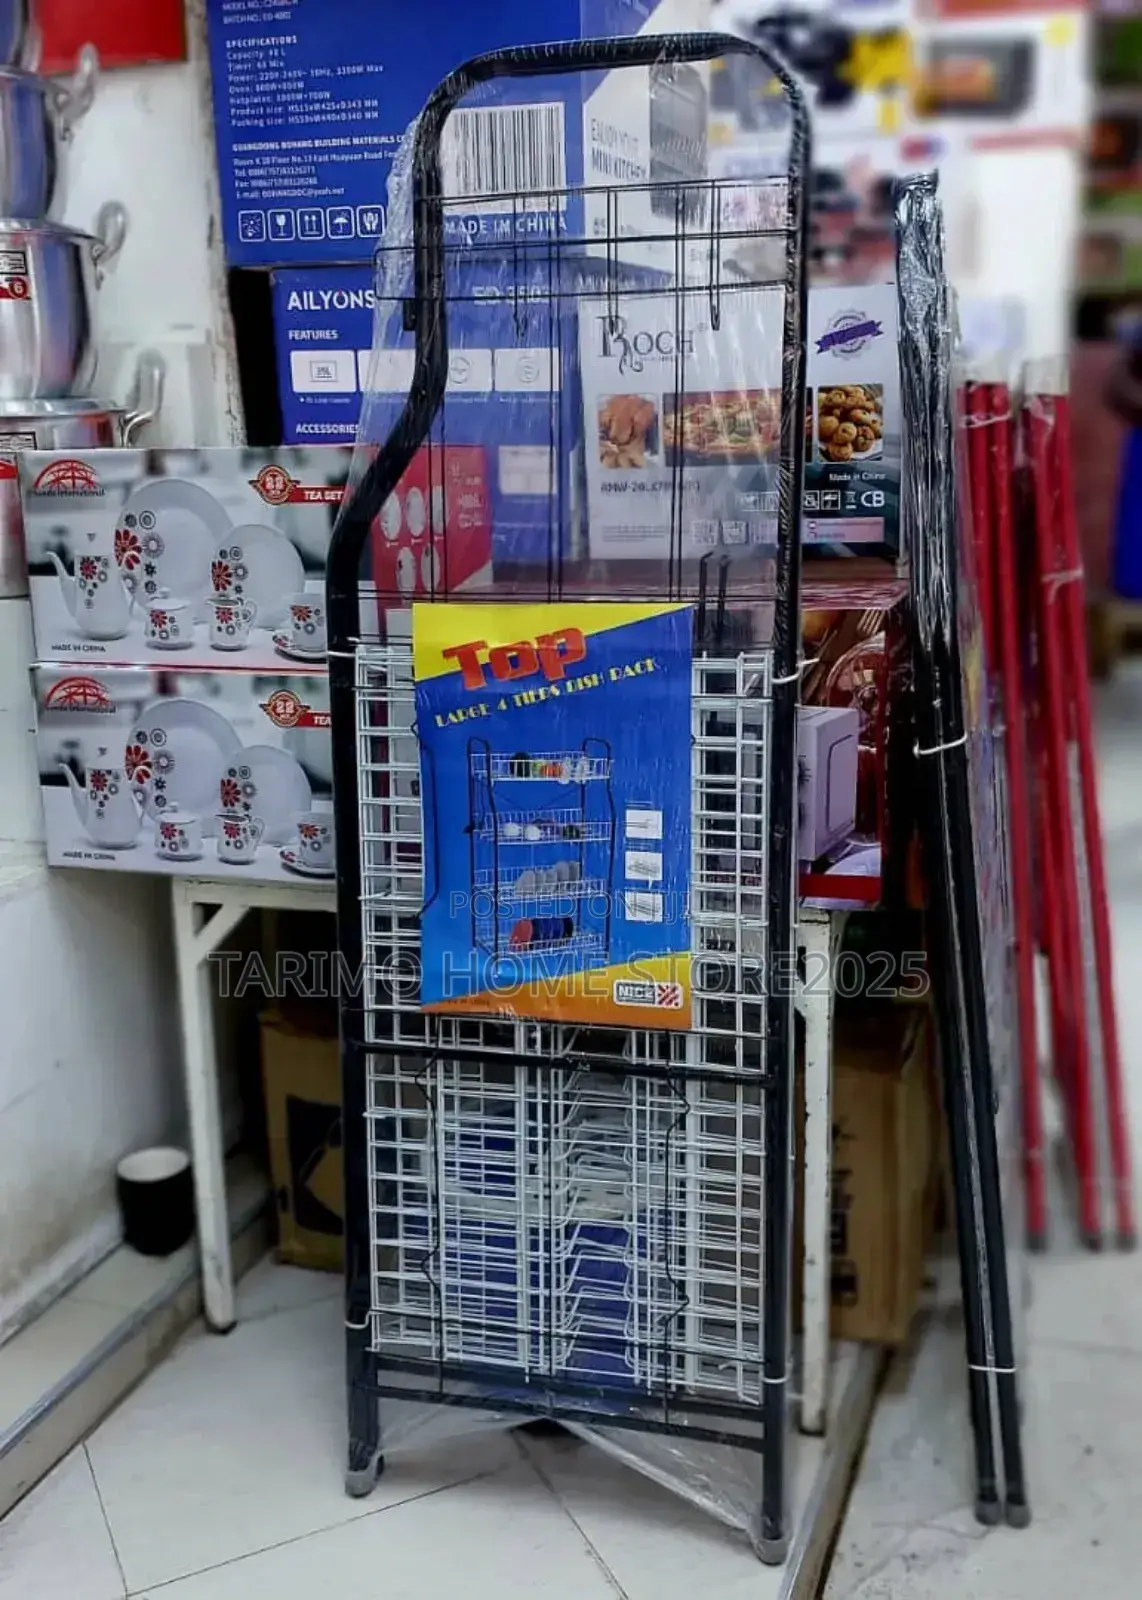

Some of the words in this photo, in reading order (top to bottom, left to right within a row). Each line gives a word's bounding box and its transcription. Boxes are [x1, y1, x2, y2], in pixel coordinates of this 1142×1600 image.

[226, 35, 297, 48] SPECIFICATIONS
[315, 138, 350, 147] BUILDING
[353, 135, 395, 145] MATERIALS
[445, 219, 488, 235] MADE
[516, 214, 567, 233] CHINA
[287, 289, 375, 311] AILYONS
[288, 329, 339, 341] FEATURES
[295, 423, 361, 434] ACCESSORIES
[305, 491, 322, 500] TEA
[324, 491, 344, 500] SET
[861, 490, 885, 508] CB
[435, 703, 491, 728] LARGE
[497, 698, 508, 711] 4
[609, 657, 661, 682] RACK
